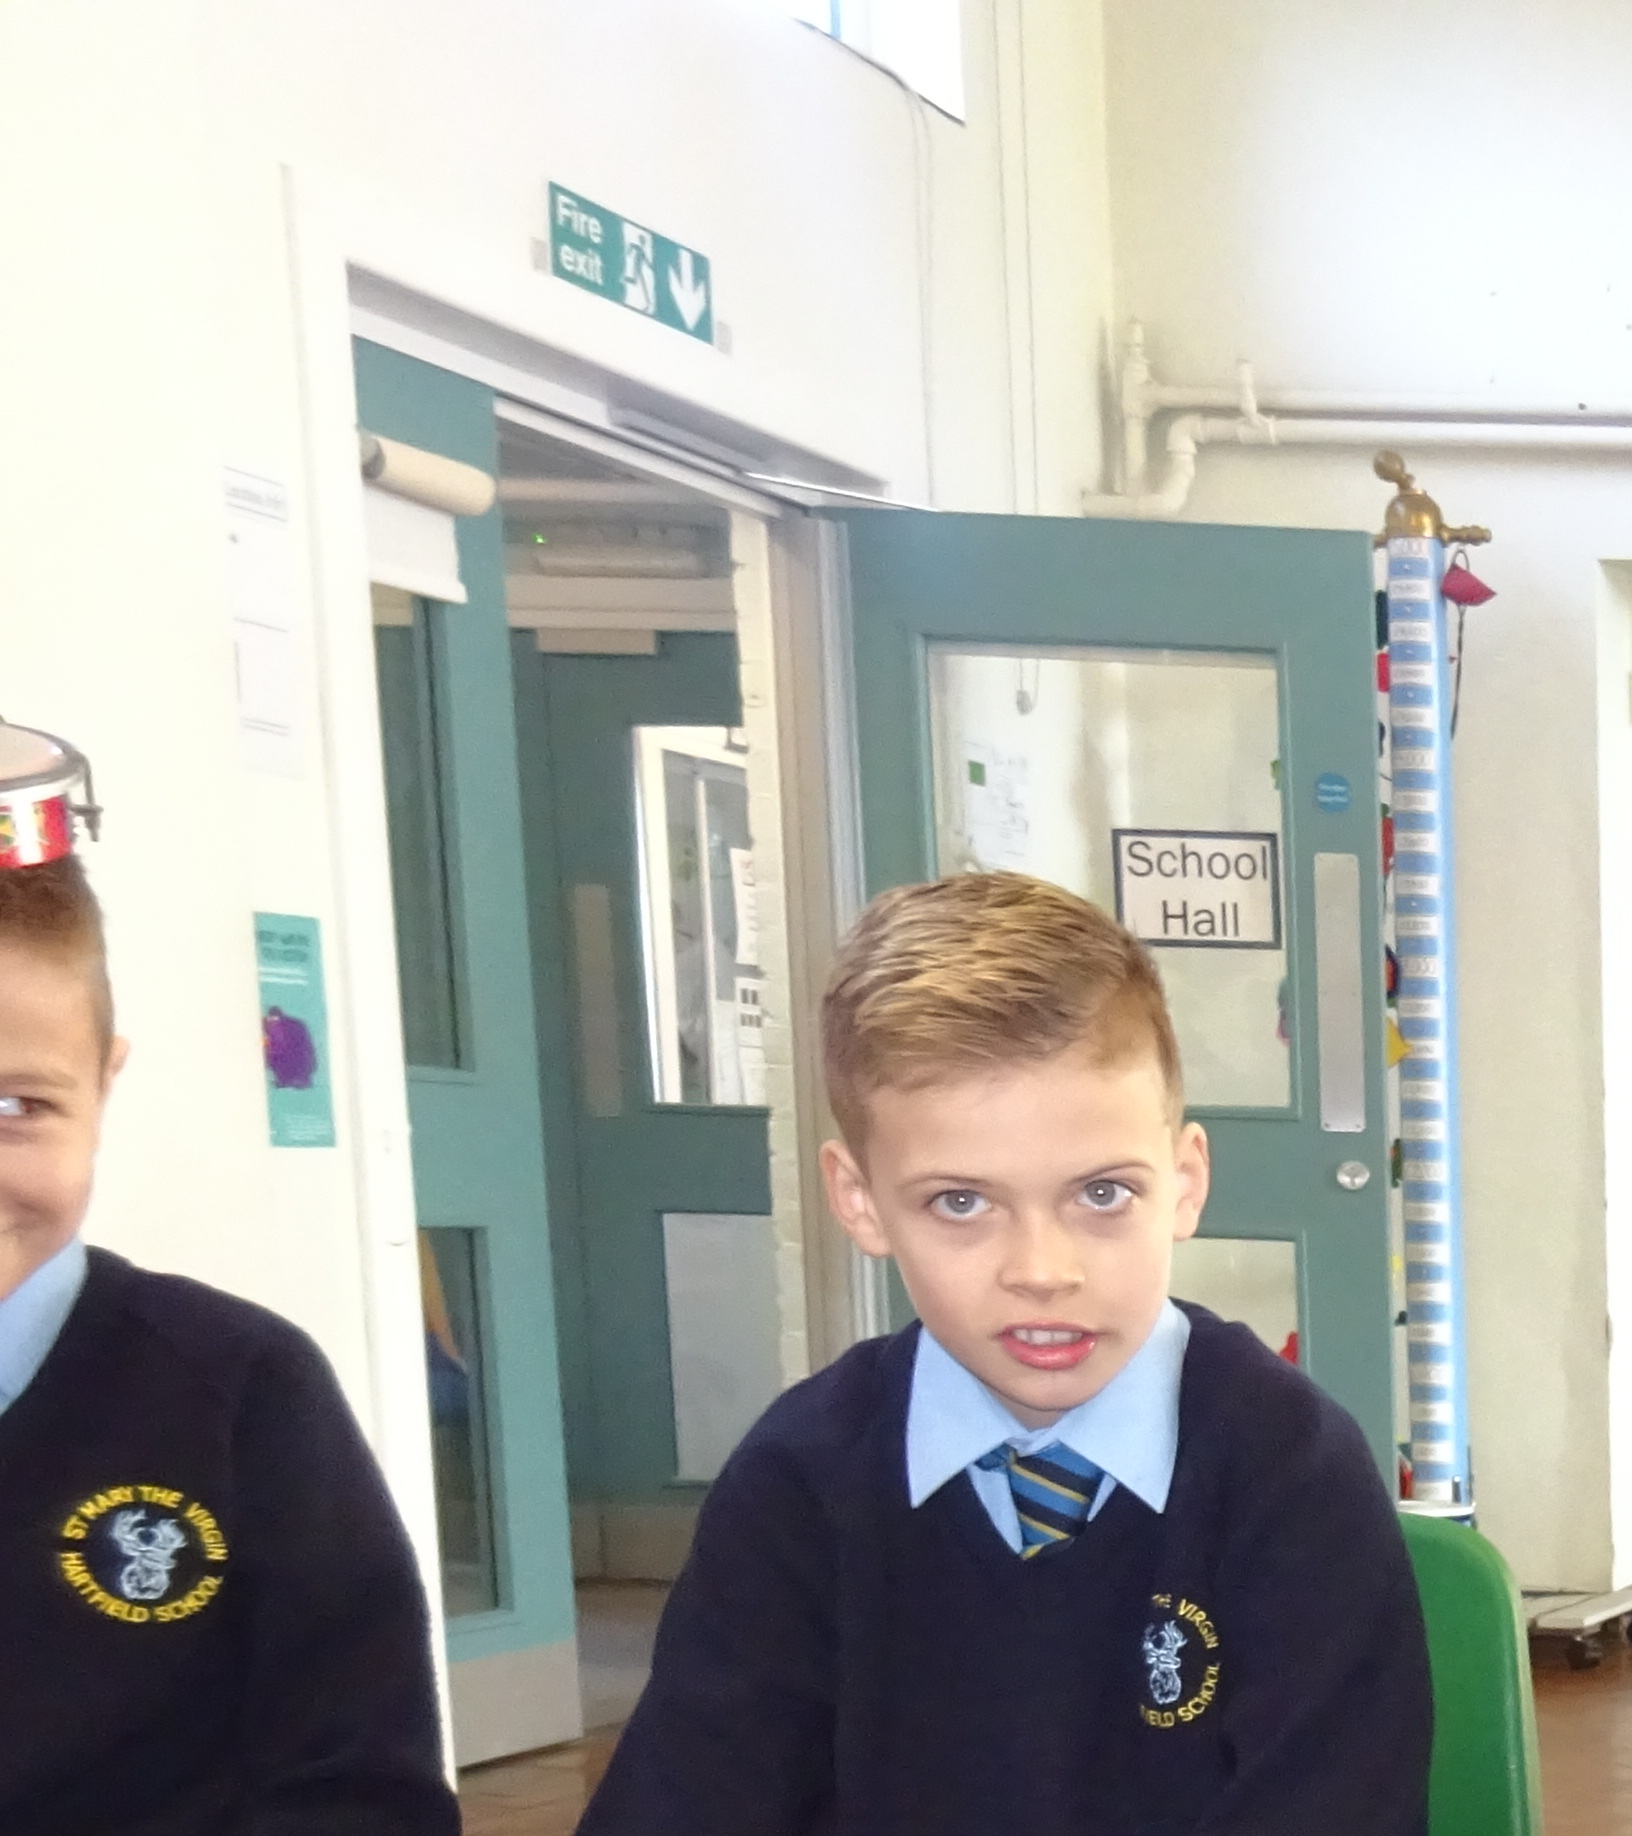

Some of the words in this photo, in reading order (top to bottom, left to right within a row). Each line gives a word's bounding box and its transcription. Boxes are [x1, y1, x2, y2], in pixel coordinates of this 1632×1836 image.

[555, 192, 603, 244] Fire
[559, 243, 604, 286] exit
[1127, 840, 1268, 881] School
[1162, 899, 1239, 938] Hall
[60, 1514, 89, 1540] ST
[76, 1484, 135, 1520] MARY
[137, 1484, 185, 1509] THE
[1176, 1598, 1220, 1649] VIRGIN
[1177, 1661, 1221, 1722] SCHOOL
